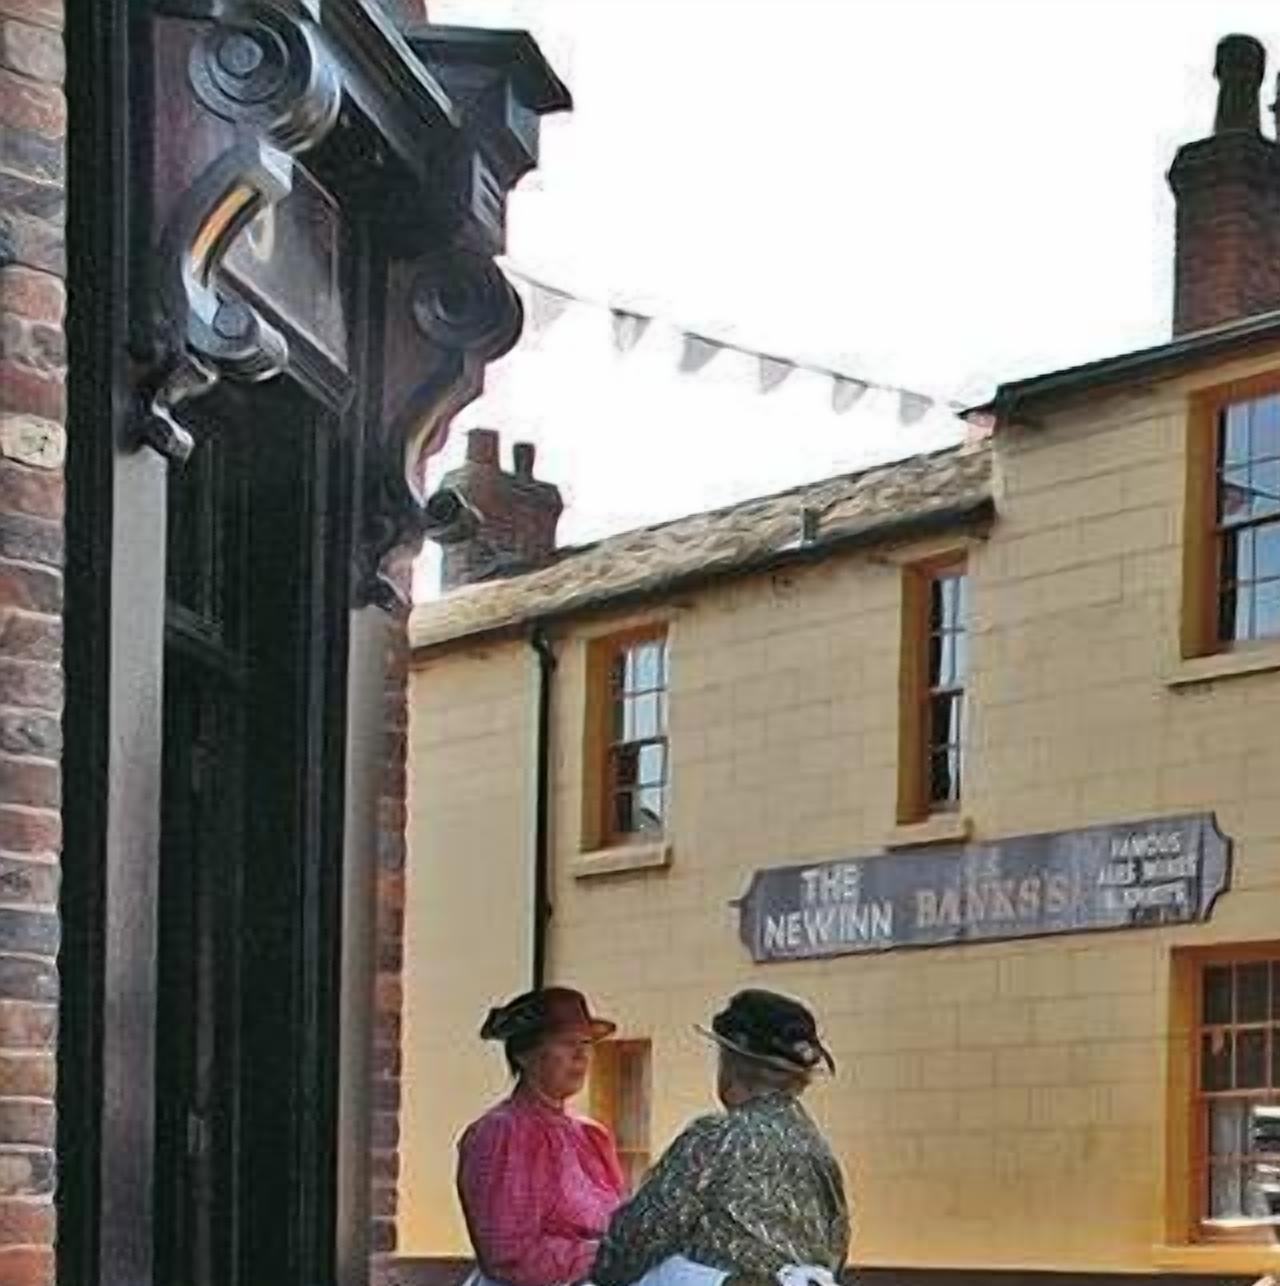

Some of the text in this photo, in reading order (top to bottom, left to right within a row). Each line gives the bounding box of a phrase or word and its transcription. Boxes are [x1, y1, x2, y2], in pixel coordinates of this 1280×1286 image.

[800, 863, 861, 901] THE
[764, 899, 893, 948] NEW INN
